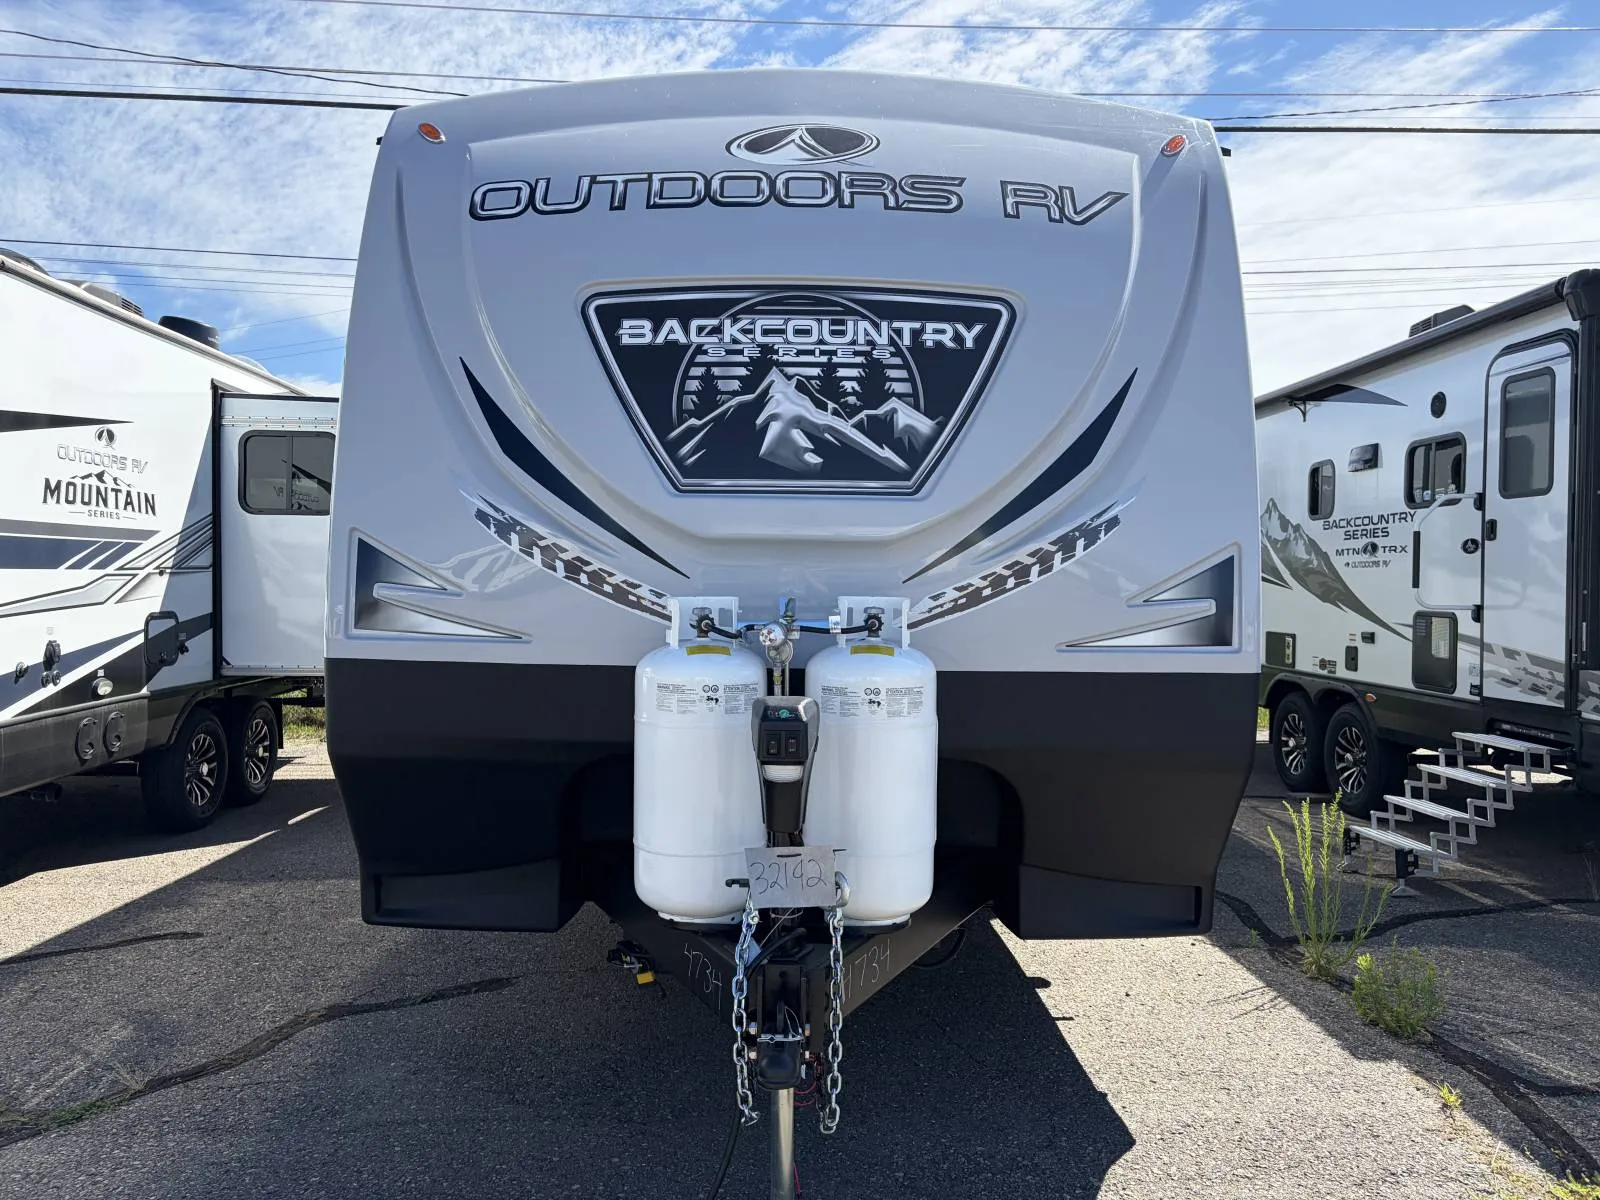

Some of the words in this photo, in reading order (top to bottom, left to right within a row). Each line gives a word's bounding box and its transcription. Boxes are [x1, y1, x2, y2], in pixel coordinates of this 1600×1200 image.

[469, 169, 967, 221] OUTDOORS
[999, 179, 1130, 226] RV
[616, 317, 988, 349] BACKCOUNTRY
[706, 345, 892, 360] SERIES
[57, 443, 128, 471] OUTDOORS
[131, 458, 149, 474] RV
[42, 477, 157, 517] MOUNTAIN
[87, 509, 121, 520] SERIES
[1322, 510, 1417, 531] BACKCOUNTRY
[1343, 526, 1390, 541] SERIES
[1335, 547, 1360, 557] MTN
[1380, 544, 1409, 554] TRX
[684, 943, 722, 1010] 4734
